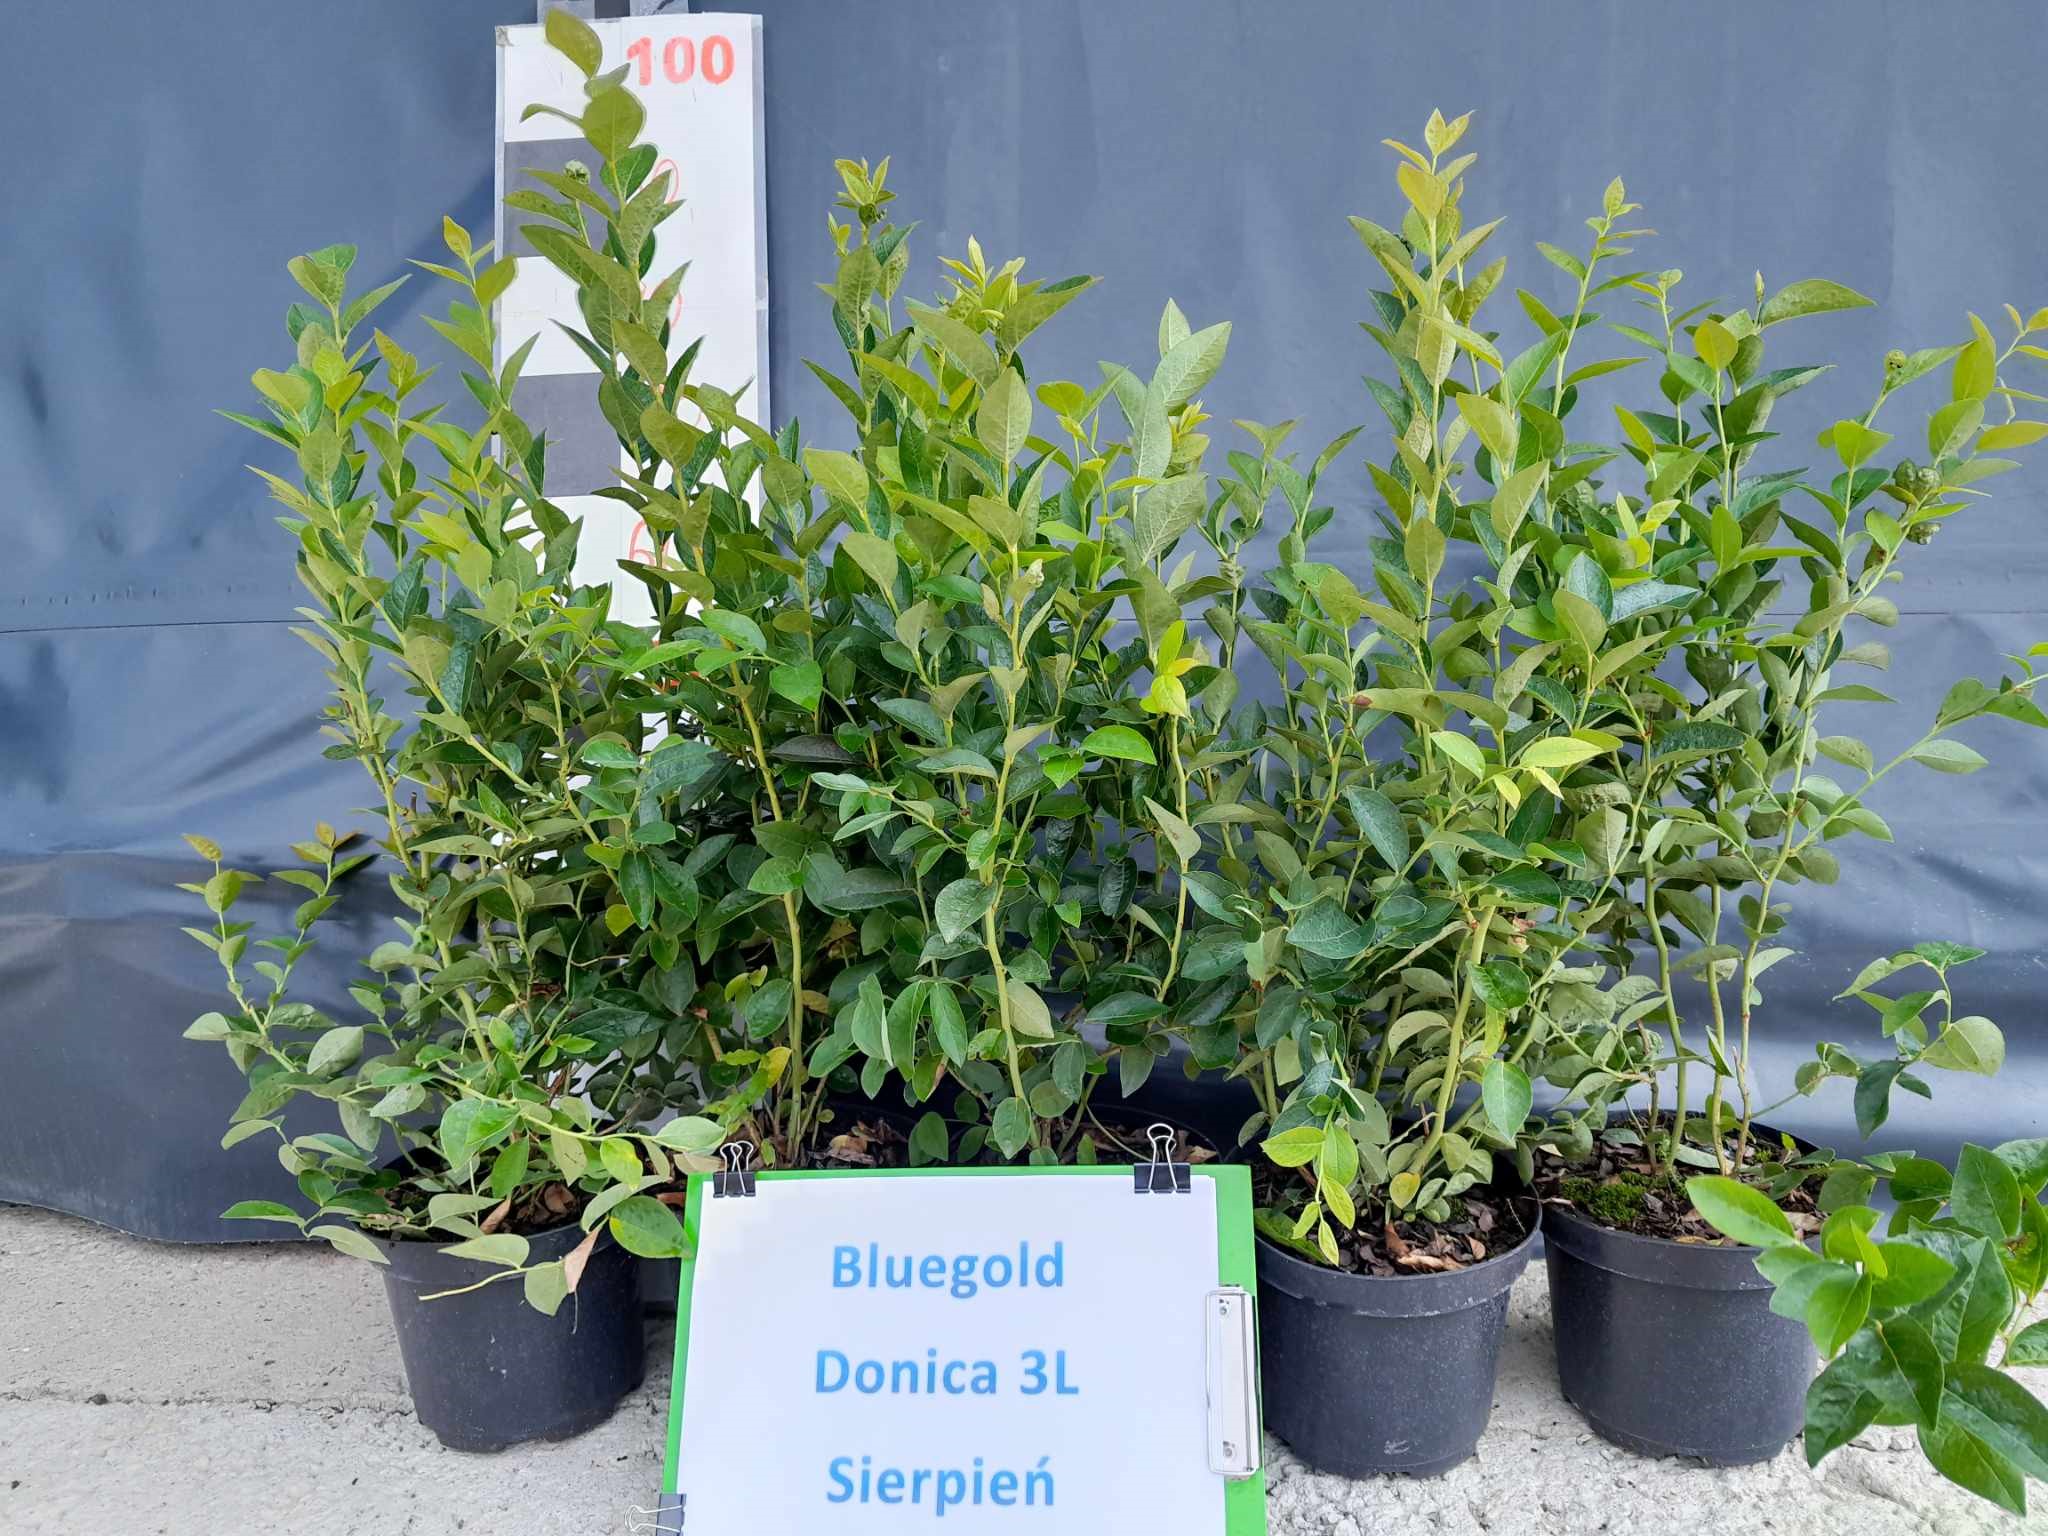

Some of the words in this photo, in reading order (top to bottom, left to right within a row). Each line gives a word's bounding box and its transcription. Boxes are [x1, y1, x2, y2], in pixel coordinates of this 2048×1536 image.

[626, 34, 736, 86] 100
[832, 1240, 1065, 1300] Bluegold
[815, 1347, 998, 1396] Donica
[1019, 1349, 1081, 1396] 3L
[825, 1455, 1056, 1518] Sierpień
